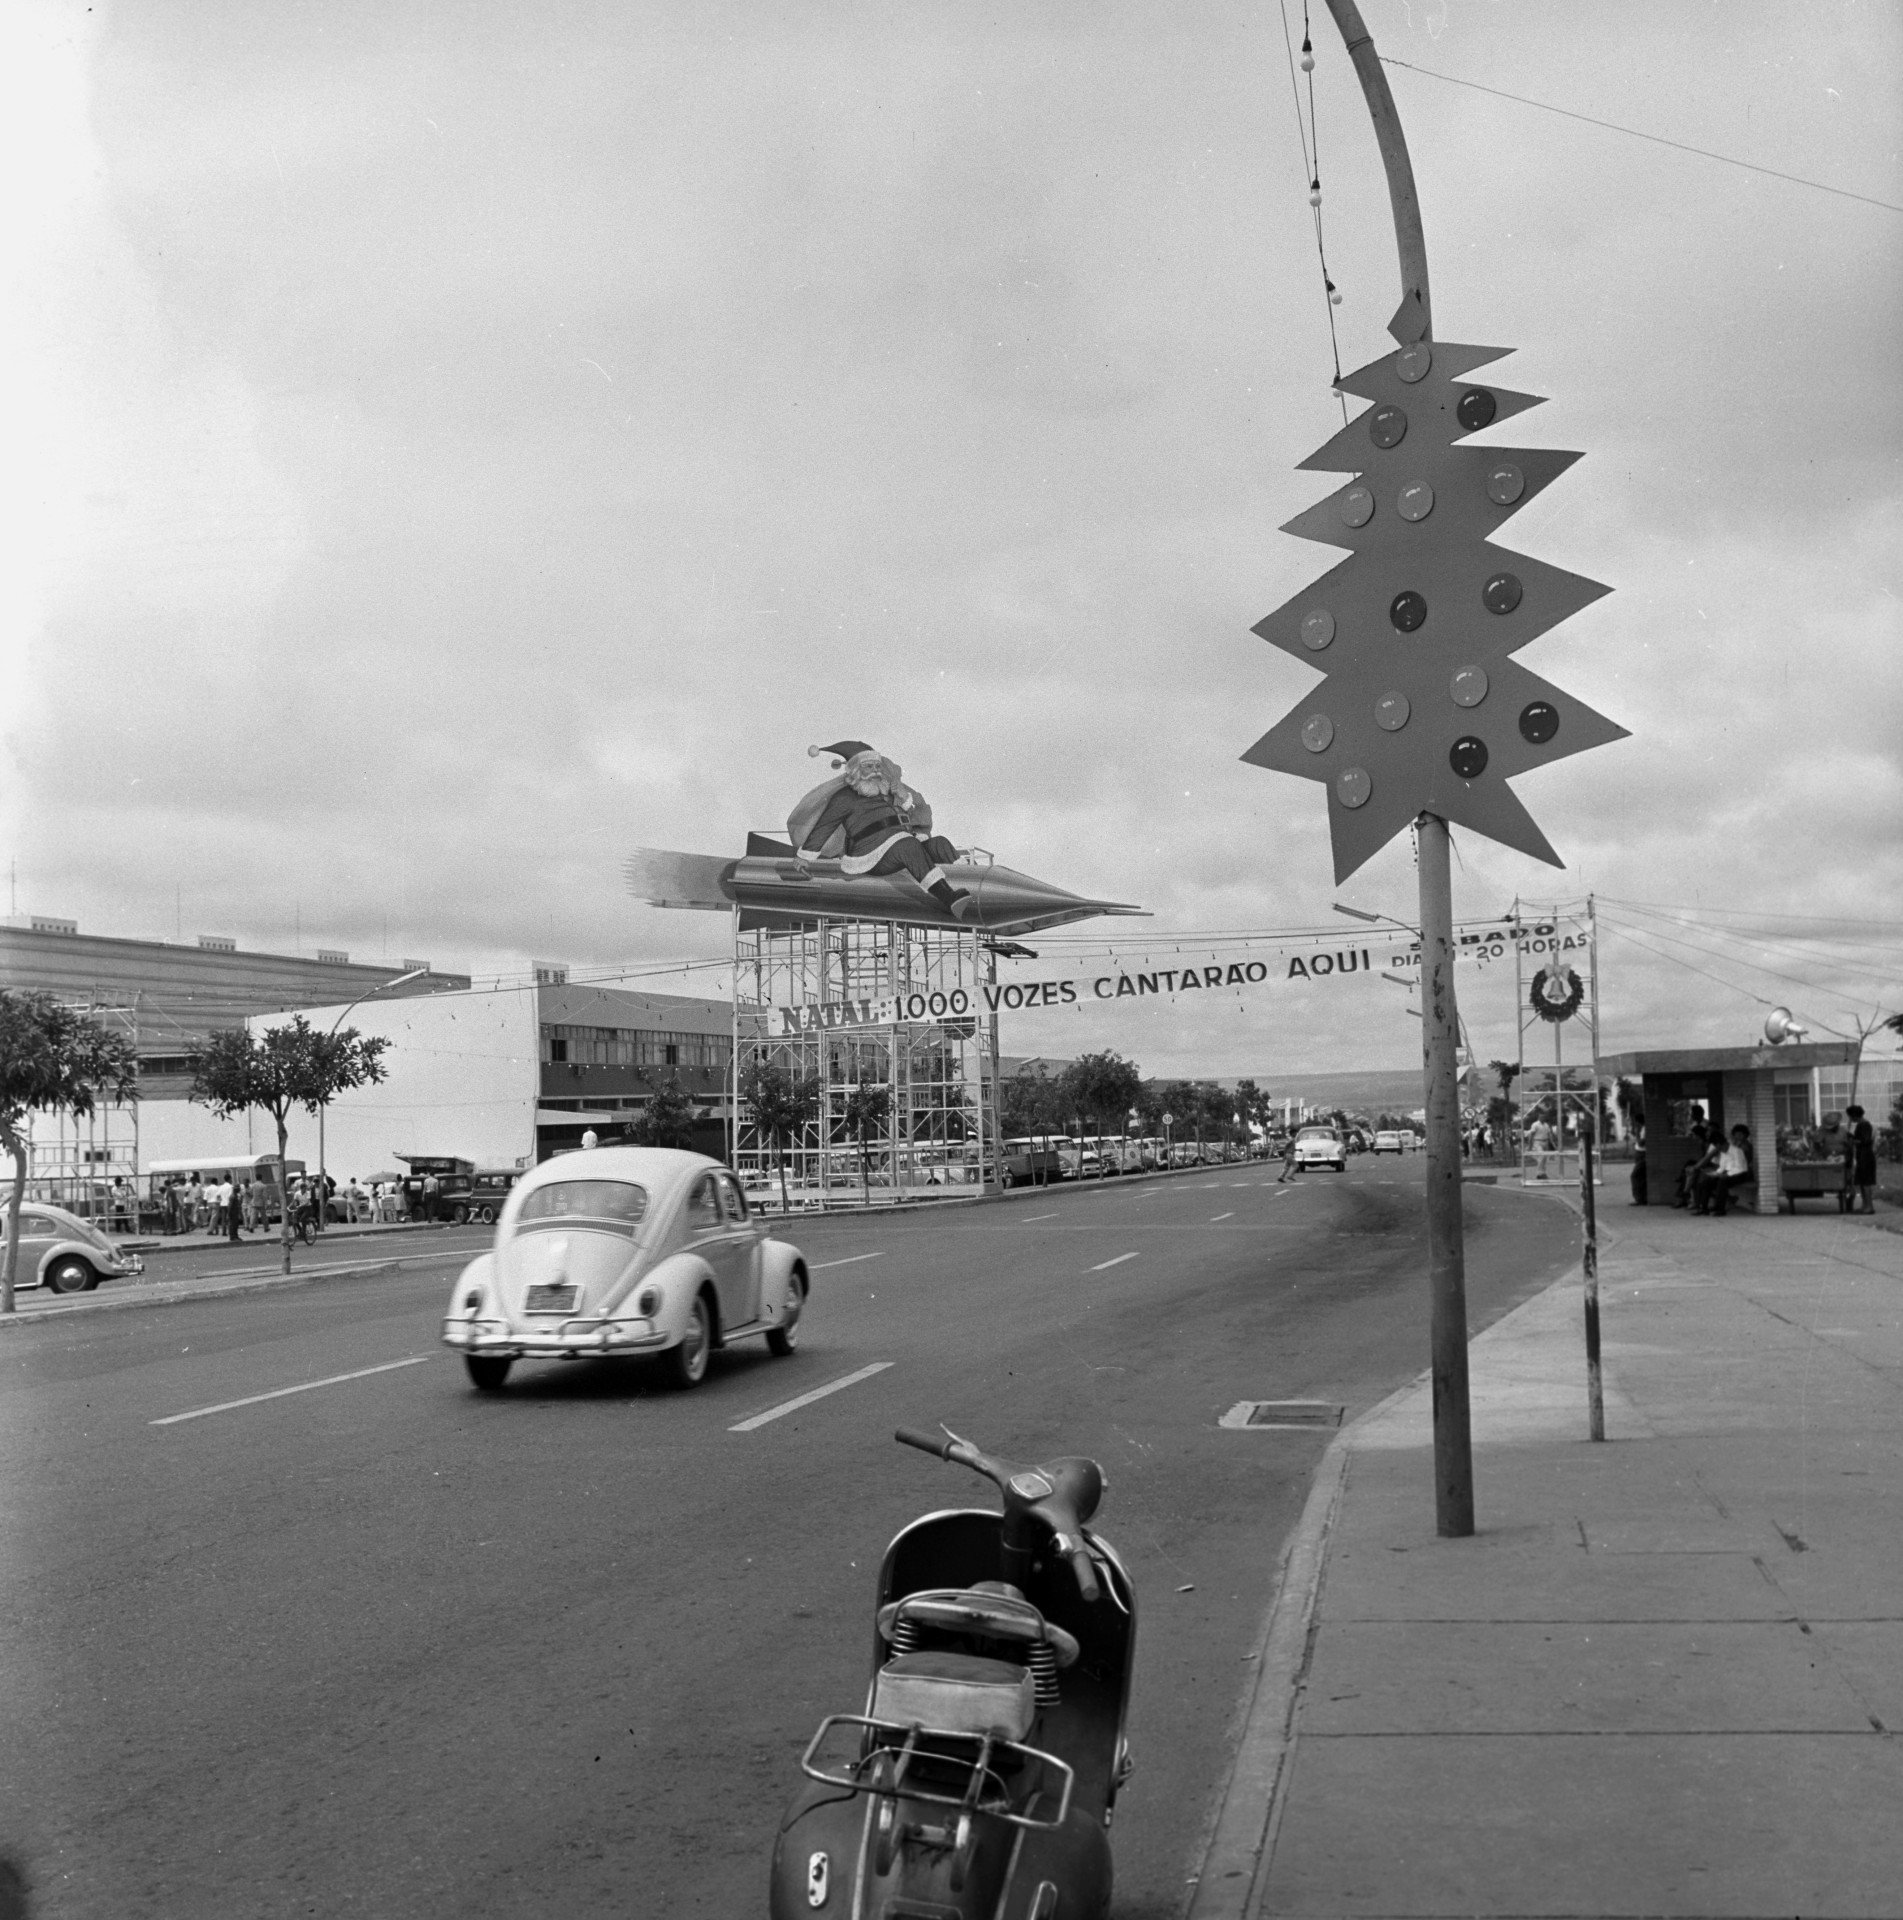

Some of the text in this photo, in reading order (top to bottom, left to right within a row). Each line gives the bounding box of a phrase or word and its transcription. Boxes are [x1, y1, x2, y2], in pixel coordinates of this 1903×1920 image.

[1410, 925, 1555, 951] SBADO
[1477, 944, 1504, 959] 20
[1518, 934, 1587, 955] HORAS
[983, 980, 1077, 1012] VOZES
[1288, 949, 1370, 980] AQUI
